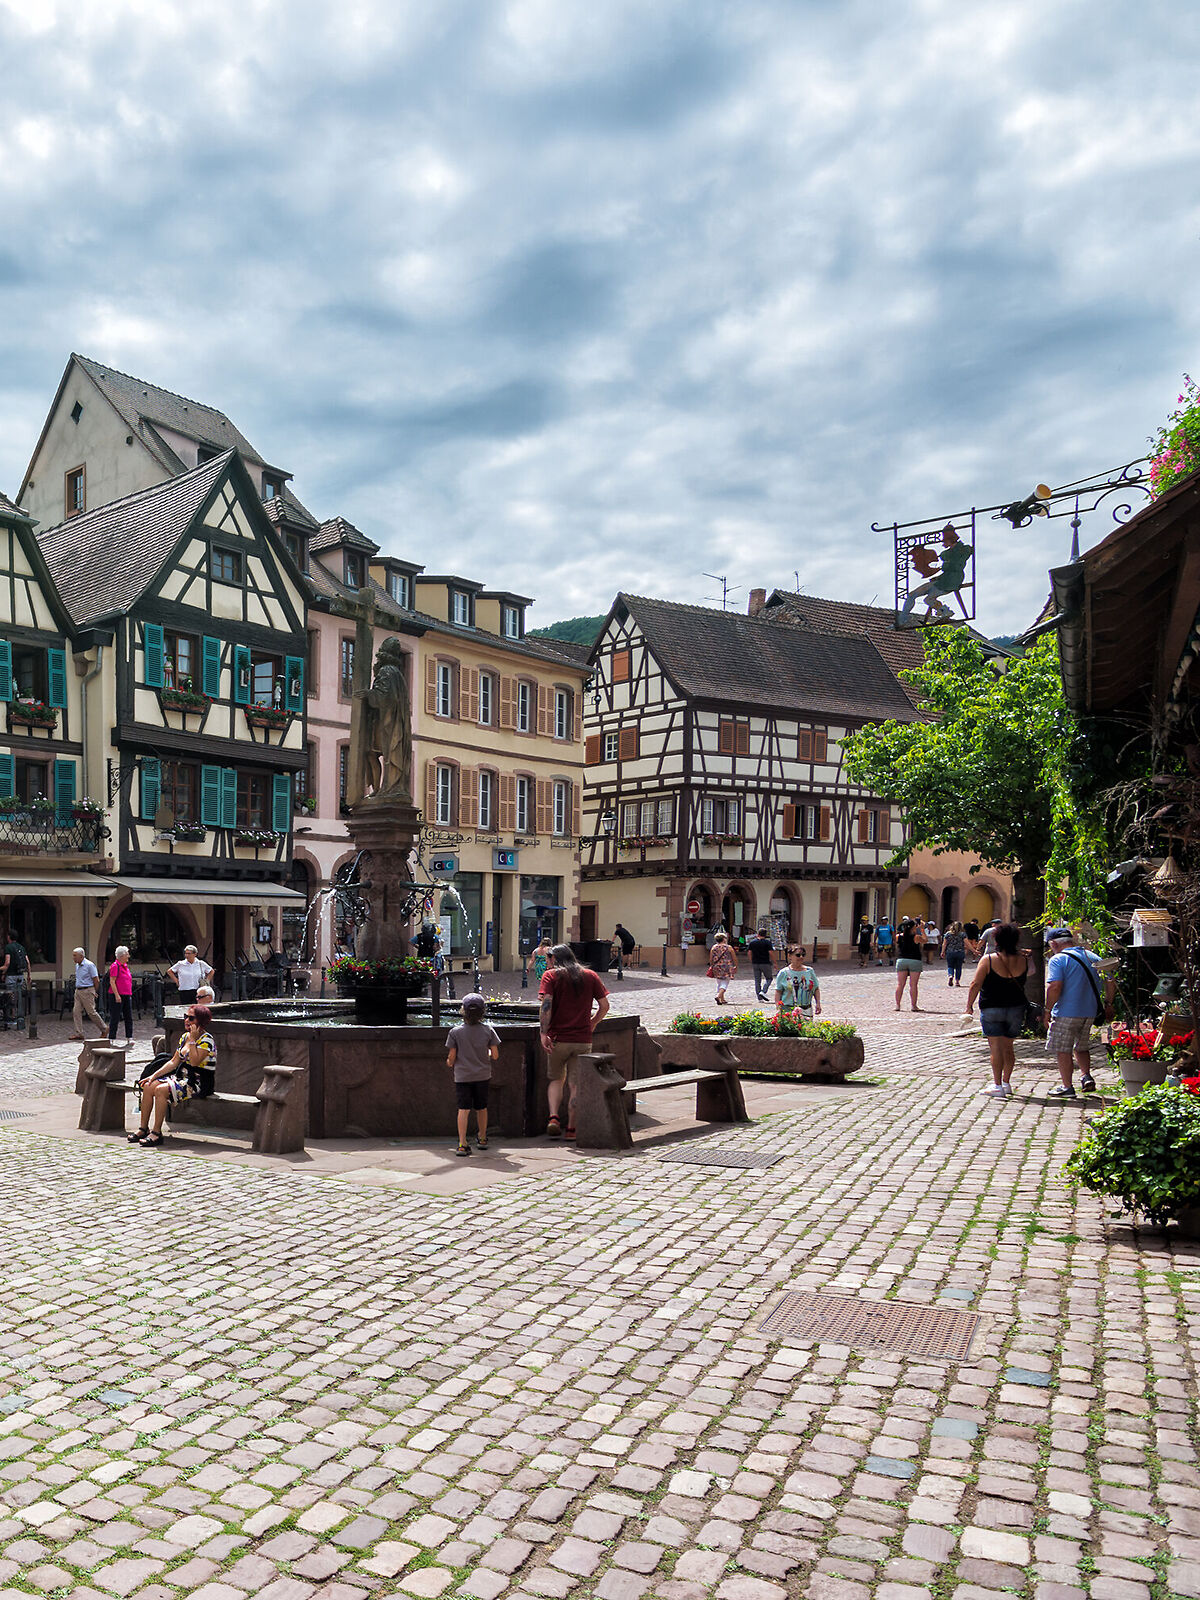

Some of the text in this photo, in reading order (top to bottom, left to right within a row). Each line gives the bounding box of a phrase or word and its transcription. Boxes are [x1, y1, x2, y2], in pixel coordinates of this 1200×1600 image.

[899, 532, 942, 548] POTIER
[499, 853, 513, 864] CIC
[435, 862, 452, 870] CIC
